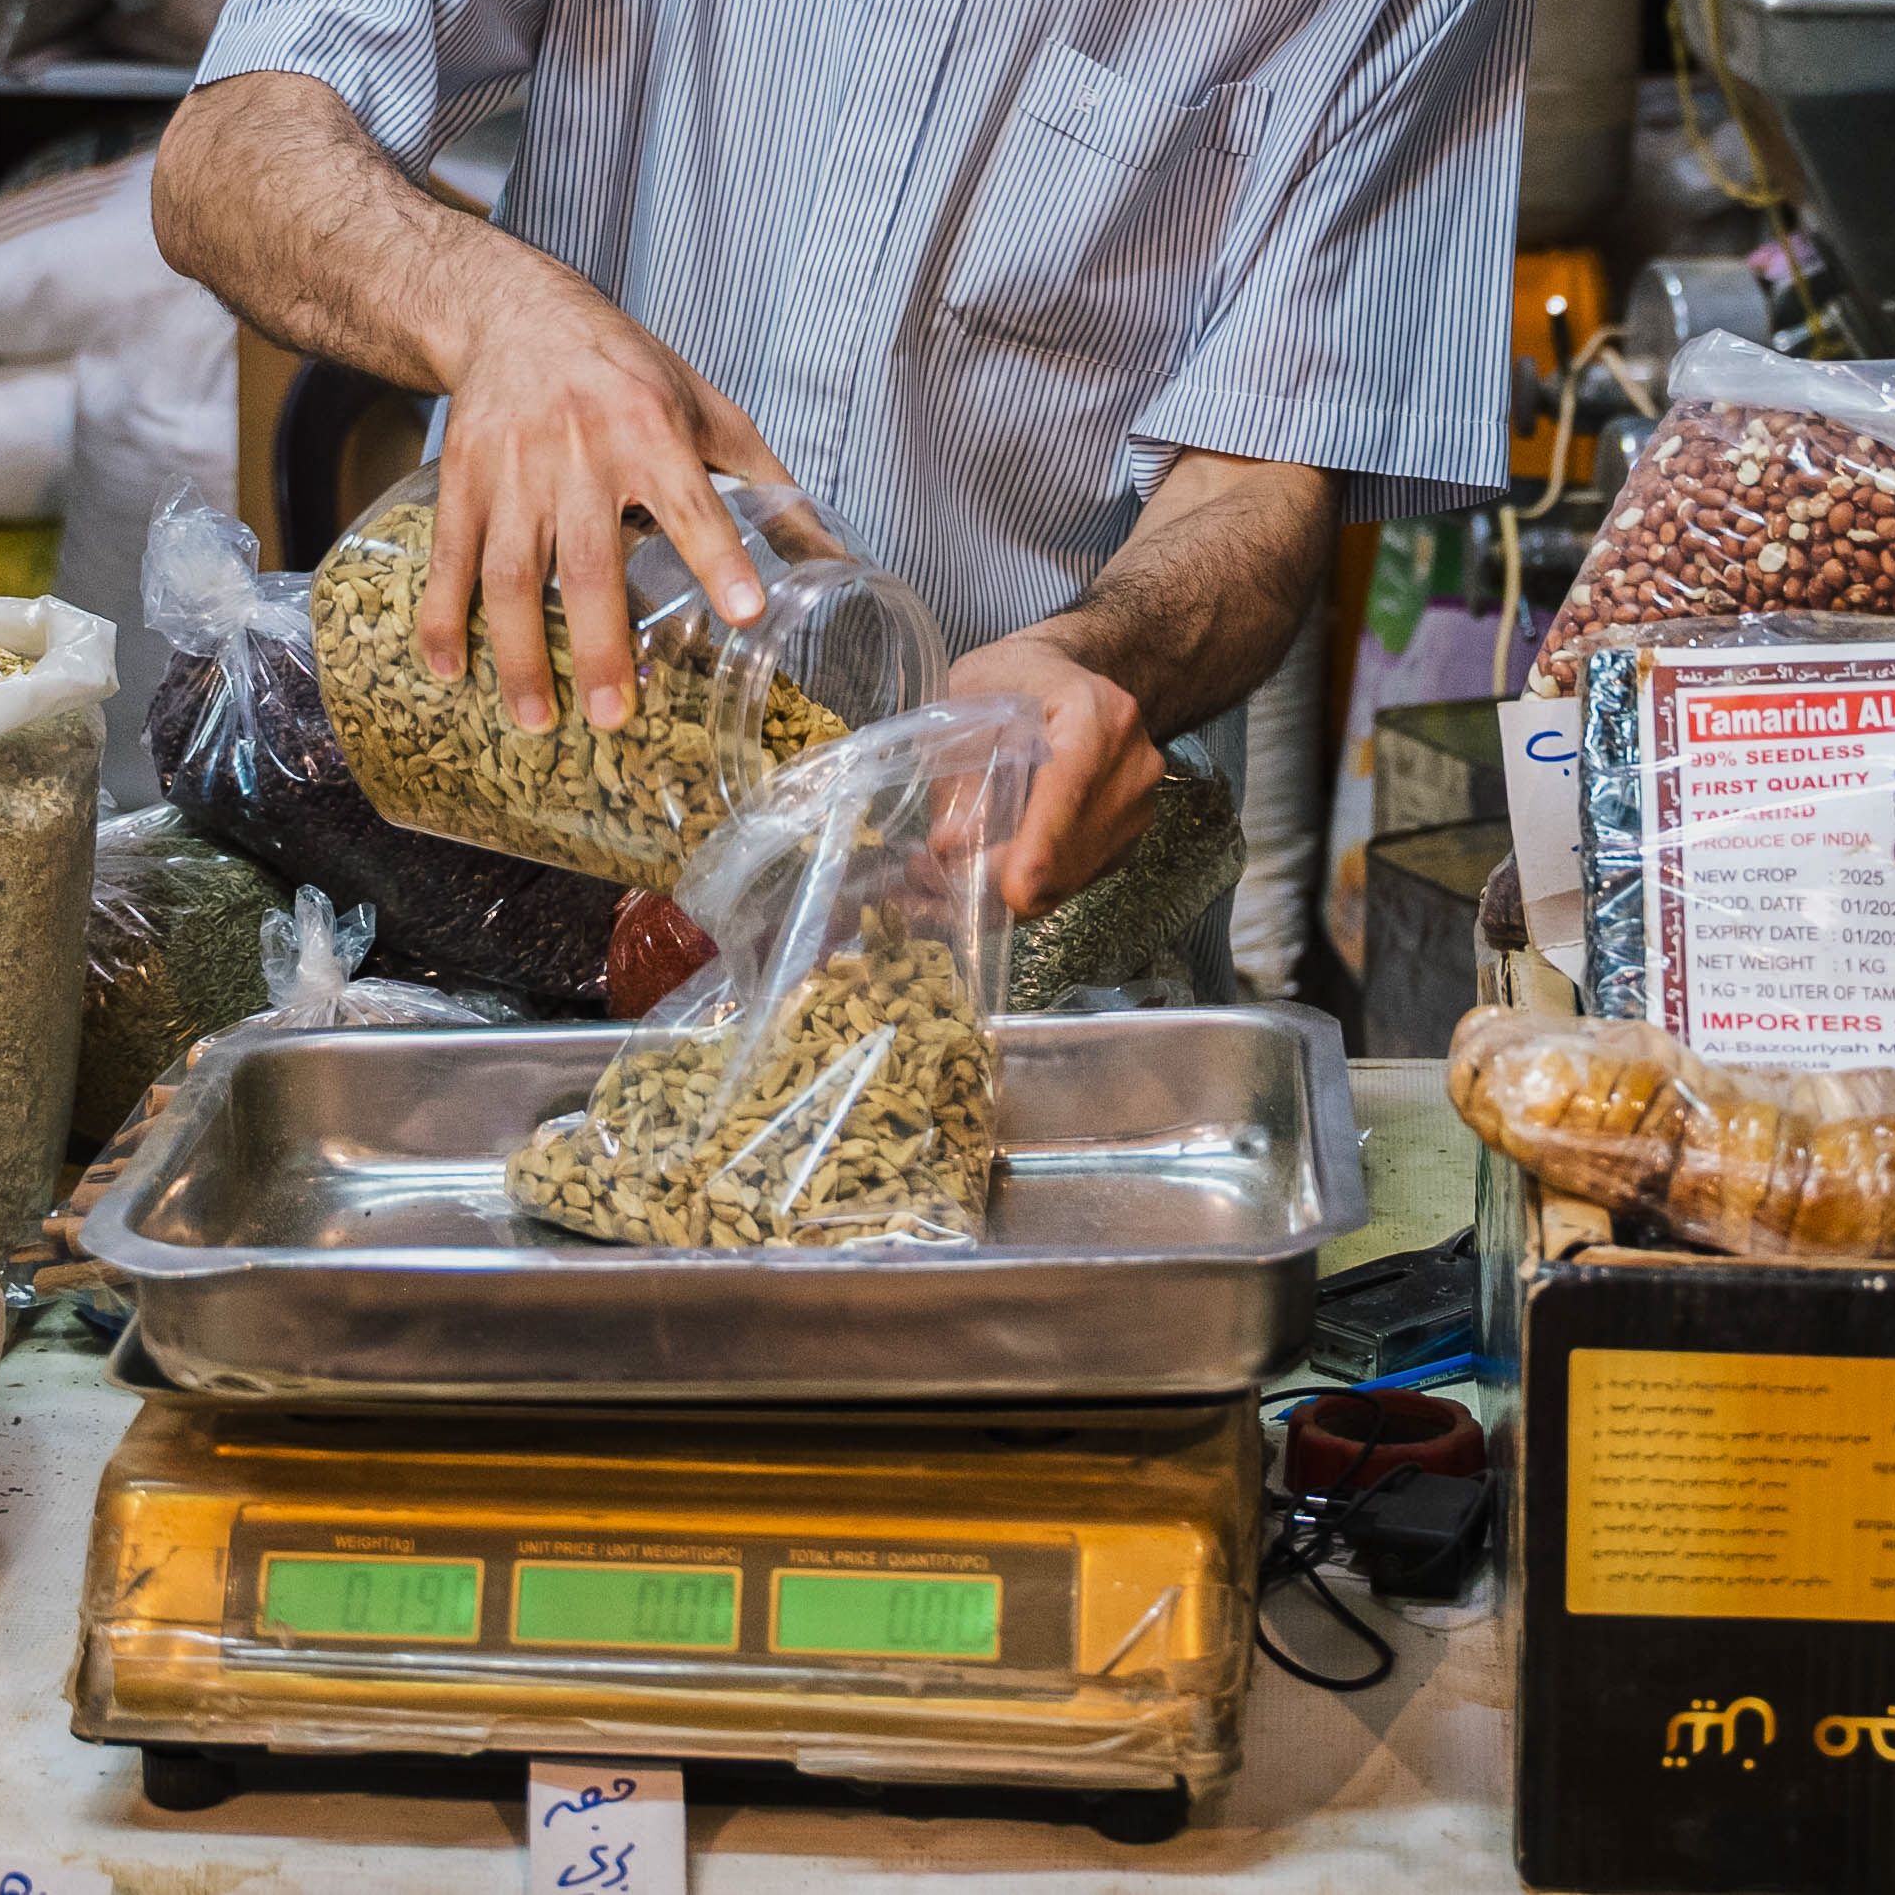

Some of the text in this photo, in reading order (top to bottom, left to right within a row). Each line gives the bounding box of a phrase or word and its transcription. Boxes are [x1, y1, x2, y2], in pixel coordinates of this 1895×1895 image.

[1675, 667, 1733, 685] المرتفعة
[1734, 663, 1796, 685] الأماكن
[1801, 668, 1819, 682] من
[1689, 699, 1847, 736] Tamarind
[1691, 744, 1866, 768] 99% SEEDLESS
[1691, 772, 1869, 797] FIRST QUALITY
[1691, 832, 1872, 851] PRODUCE OF INDIA
[1693, 867, 1884, 886] NEW CROP 2025
[1761, 896, 1807, 912] DATE
[1696, 926, 1763, 942] EXPIRY
[1770, 926, 1819, 942] DATE
[1697, 955, 1886, 975] NET WEIGHT 1 KG
[1709, 985, 1736, 998] KG
[1755, 985, 1775, 998] 20
[1779, 985, 1830, 1000] LITER
[1833, 985, 1856, 1000] OF
[1701, 1012, 1883, 1032] IMPORTERS
[1703, 1041, 1870, 1056] Al-Bazouriyah
[334, 1534, 416, 1554] WEIGHT(kg)
[518, 1540, 605, 1561] UNIT PRICE
[789, 1550, 833, 1567] TOTAL
[836, 1551, 879, 1569] PRICE
[1661, 1695, 1777, 1770] تين
